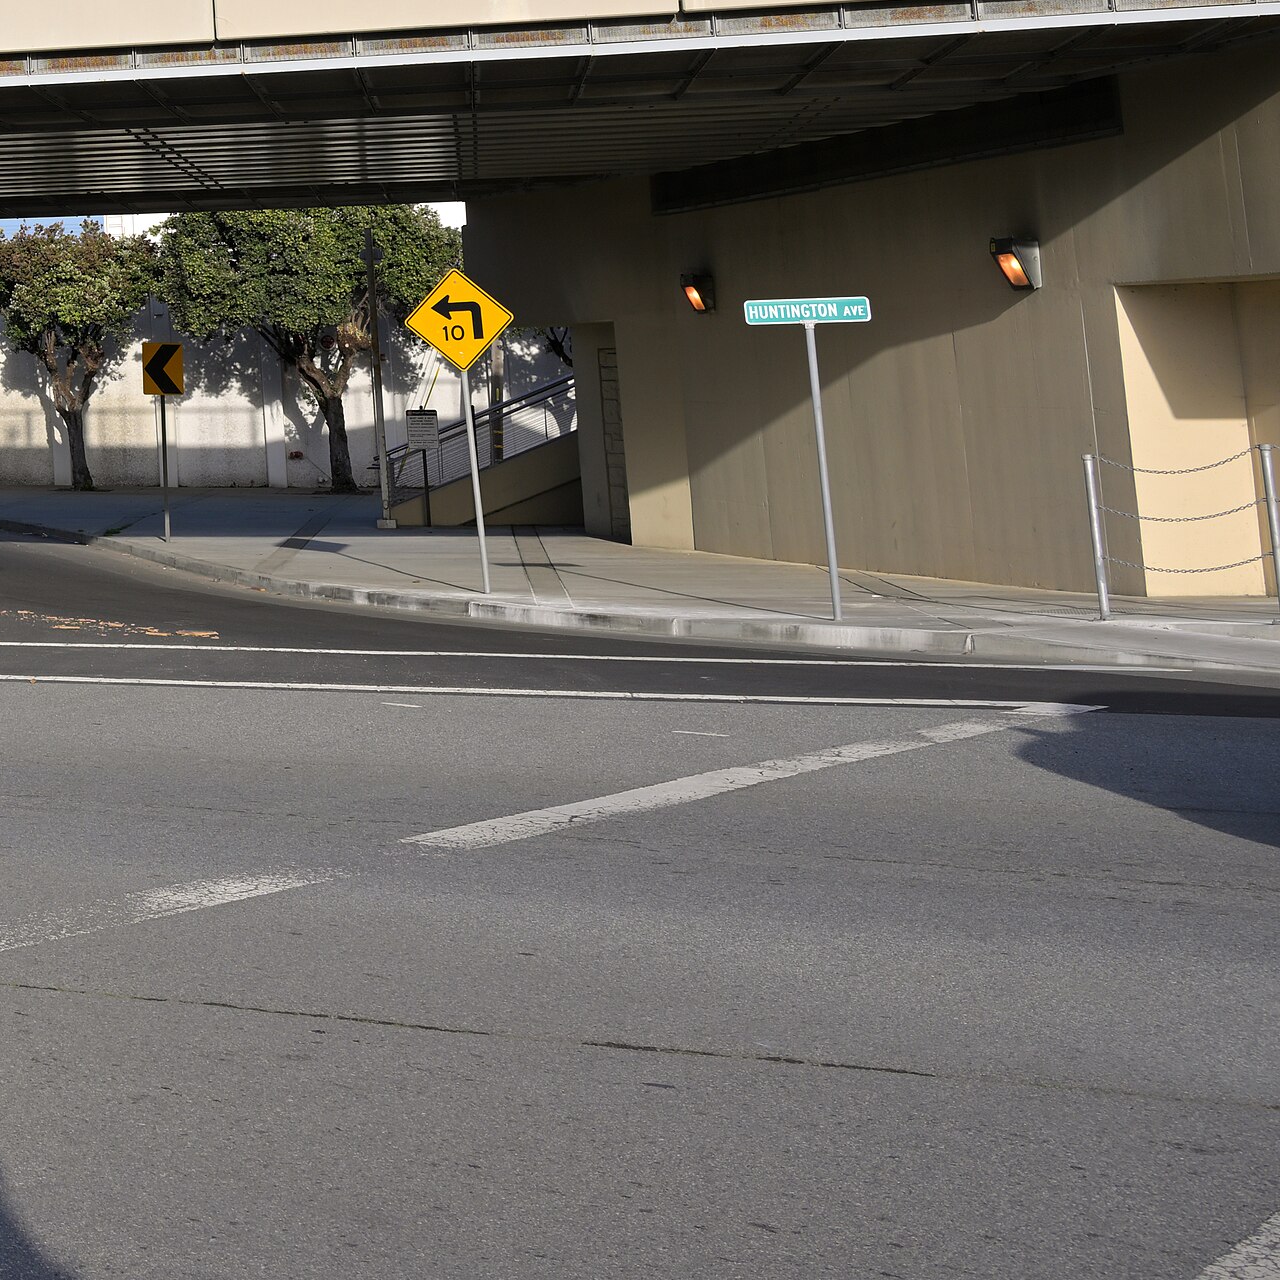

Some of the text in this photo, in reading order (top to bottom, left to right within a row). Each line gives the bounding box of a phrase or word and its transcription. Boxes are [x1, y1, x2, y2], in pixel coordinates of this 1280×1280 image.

[748, 302, 867, 320] HUNTINGTON AVE
[442, 324, 465, 342] 10
